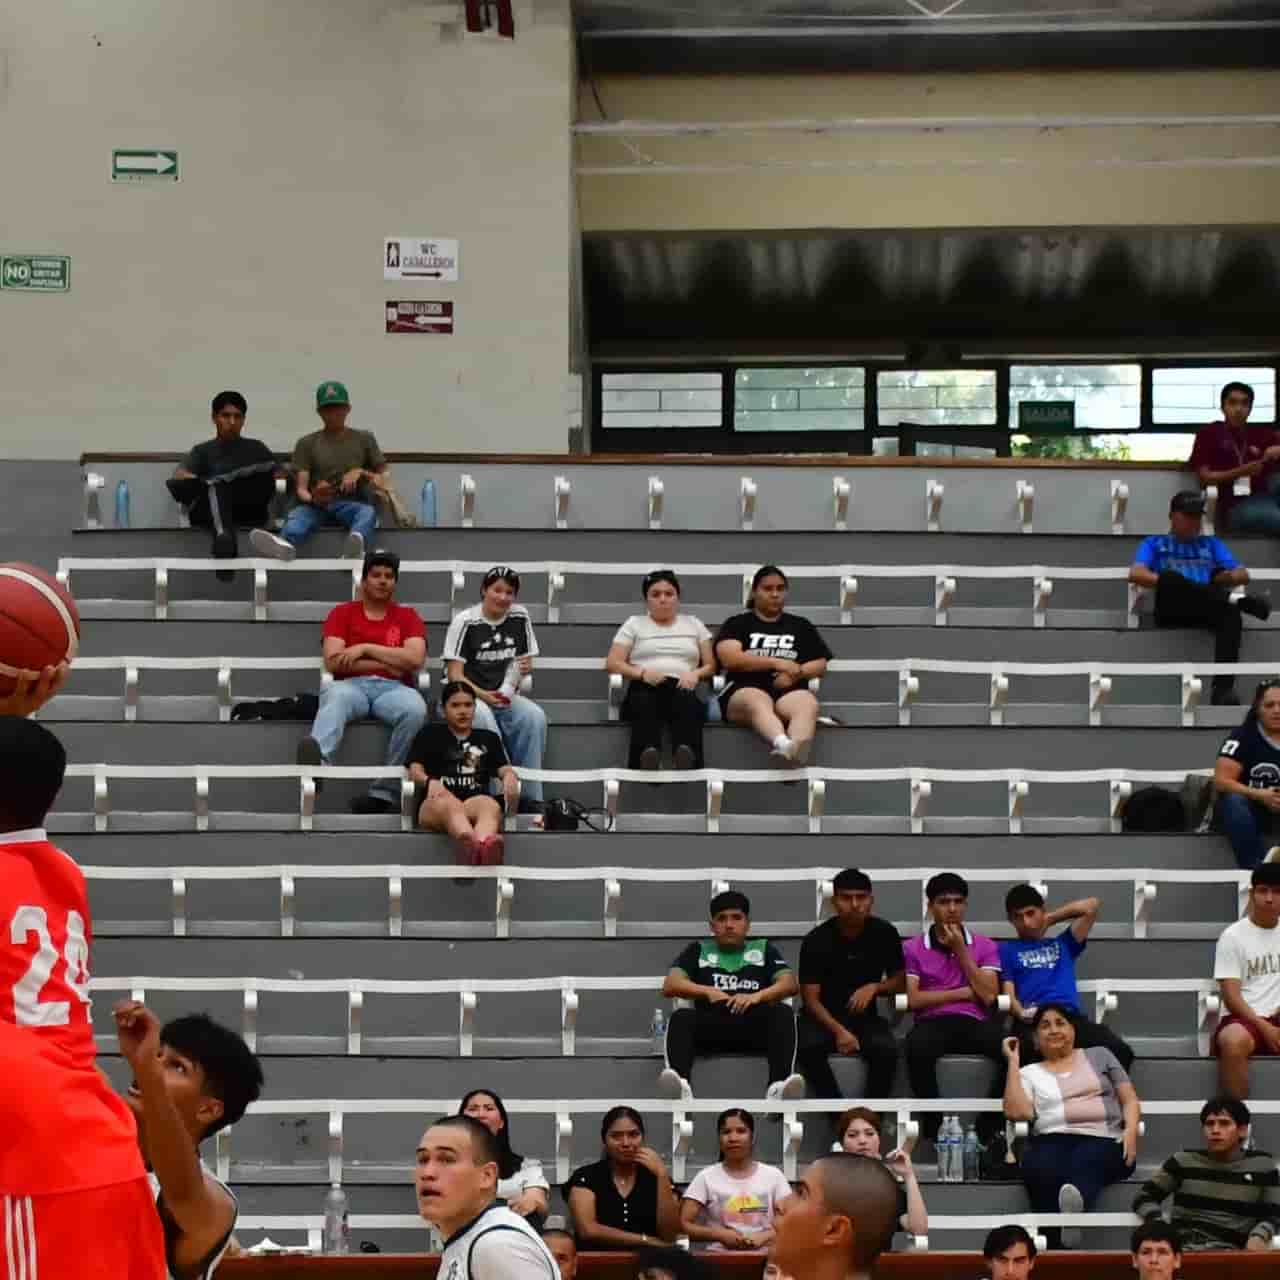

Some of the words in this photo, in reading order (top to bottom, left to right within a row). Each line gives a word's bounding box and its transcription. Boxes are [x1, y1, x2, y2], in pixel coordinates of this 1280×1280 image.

[420, 243, 438, 255] WC
[6, 264, 29, 280] NO
[749, 632, 795, 649] TEC
